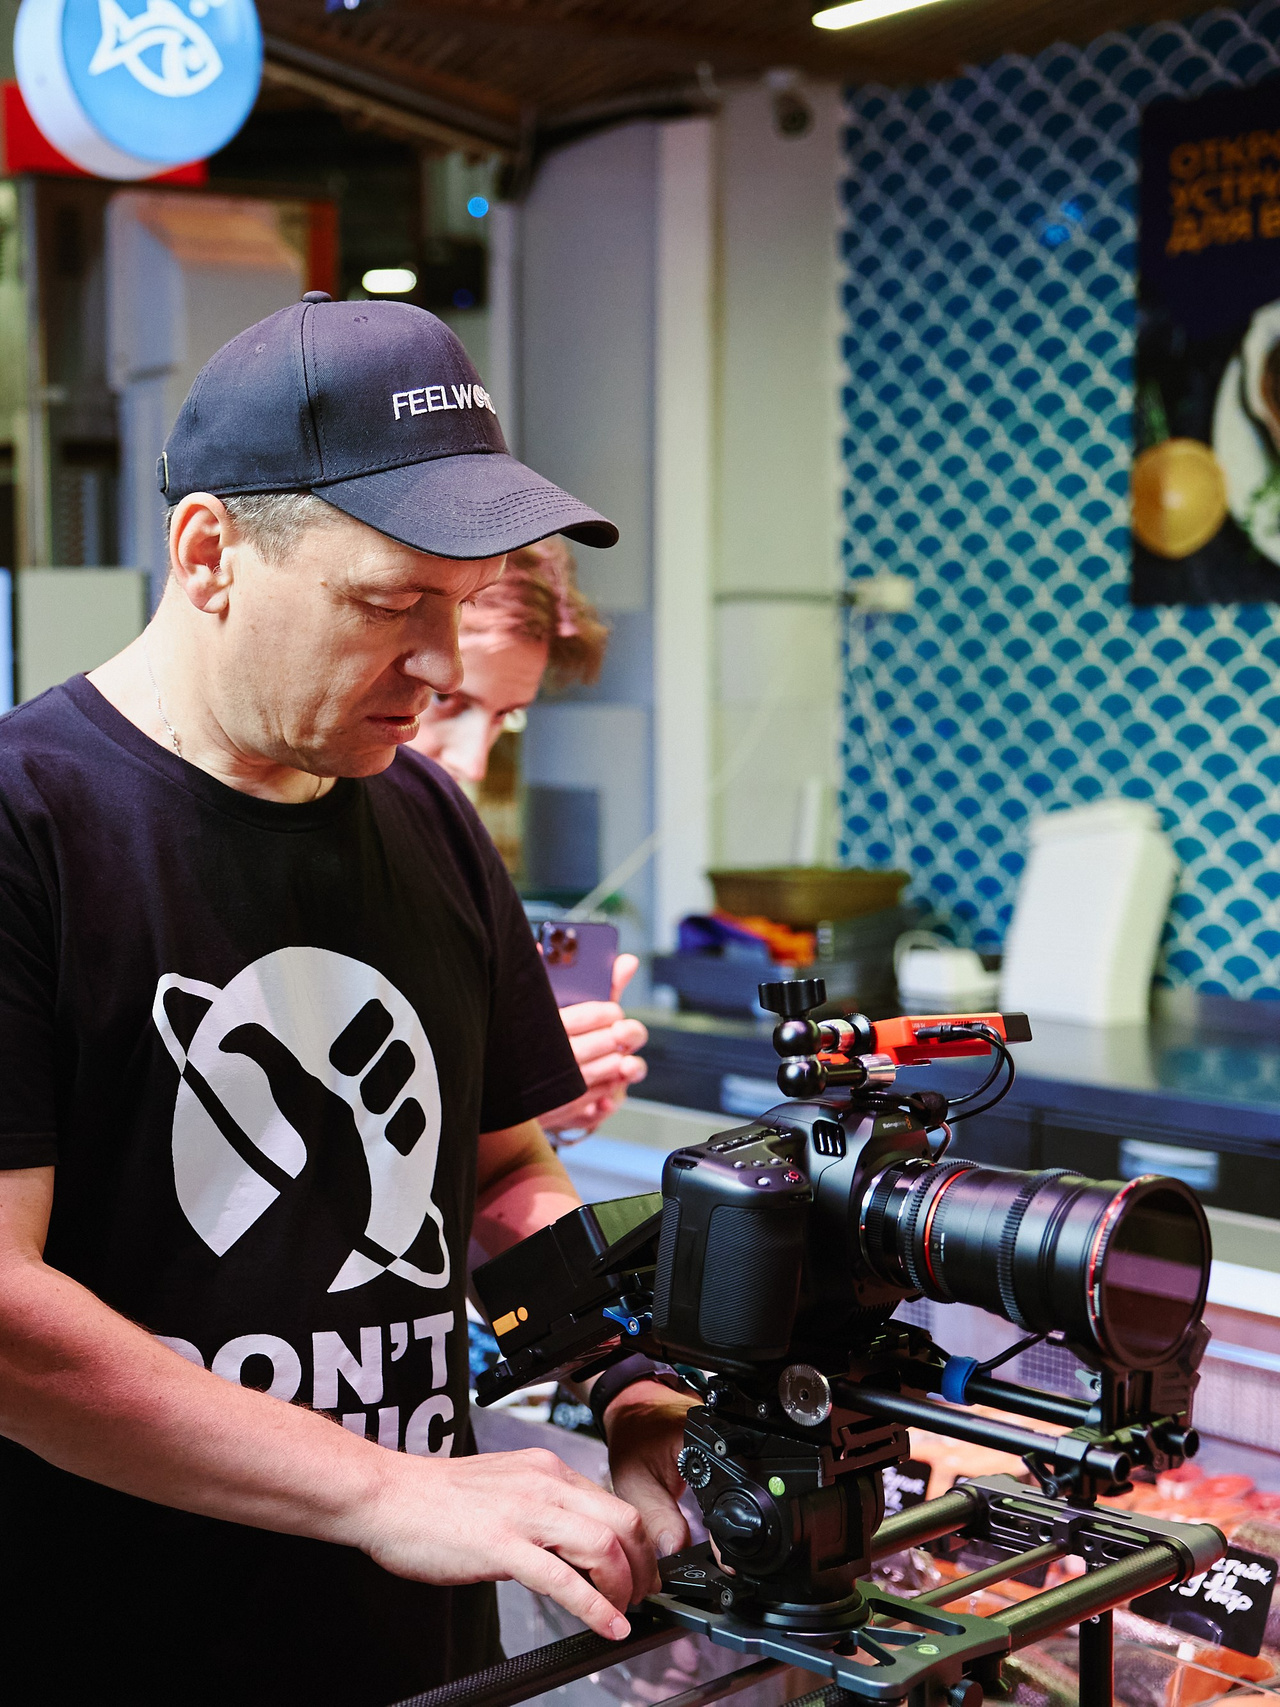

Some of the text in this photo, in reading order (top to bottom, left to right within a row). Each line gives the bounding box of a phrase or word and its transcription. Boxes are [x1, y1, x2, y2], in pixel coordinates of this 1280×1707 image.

[1169, 131, 1280, 180] ОТКР
[153, 1311, 455, 1409] ON'T
[342, 1395, 455, 1459] IC
